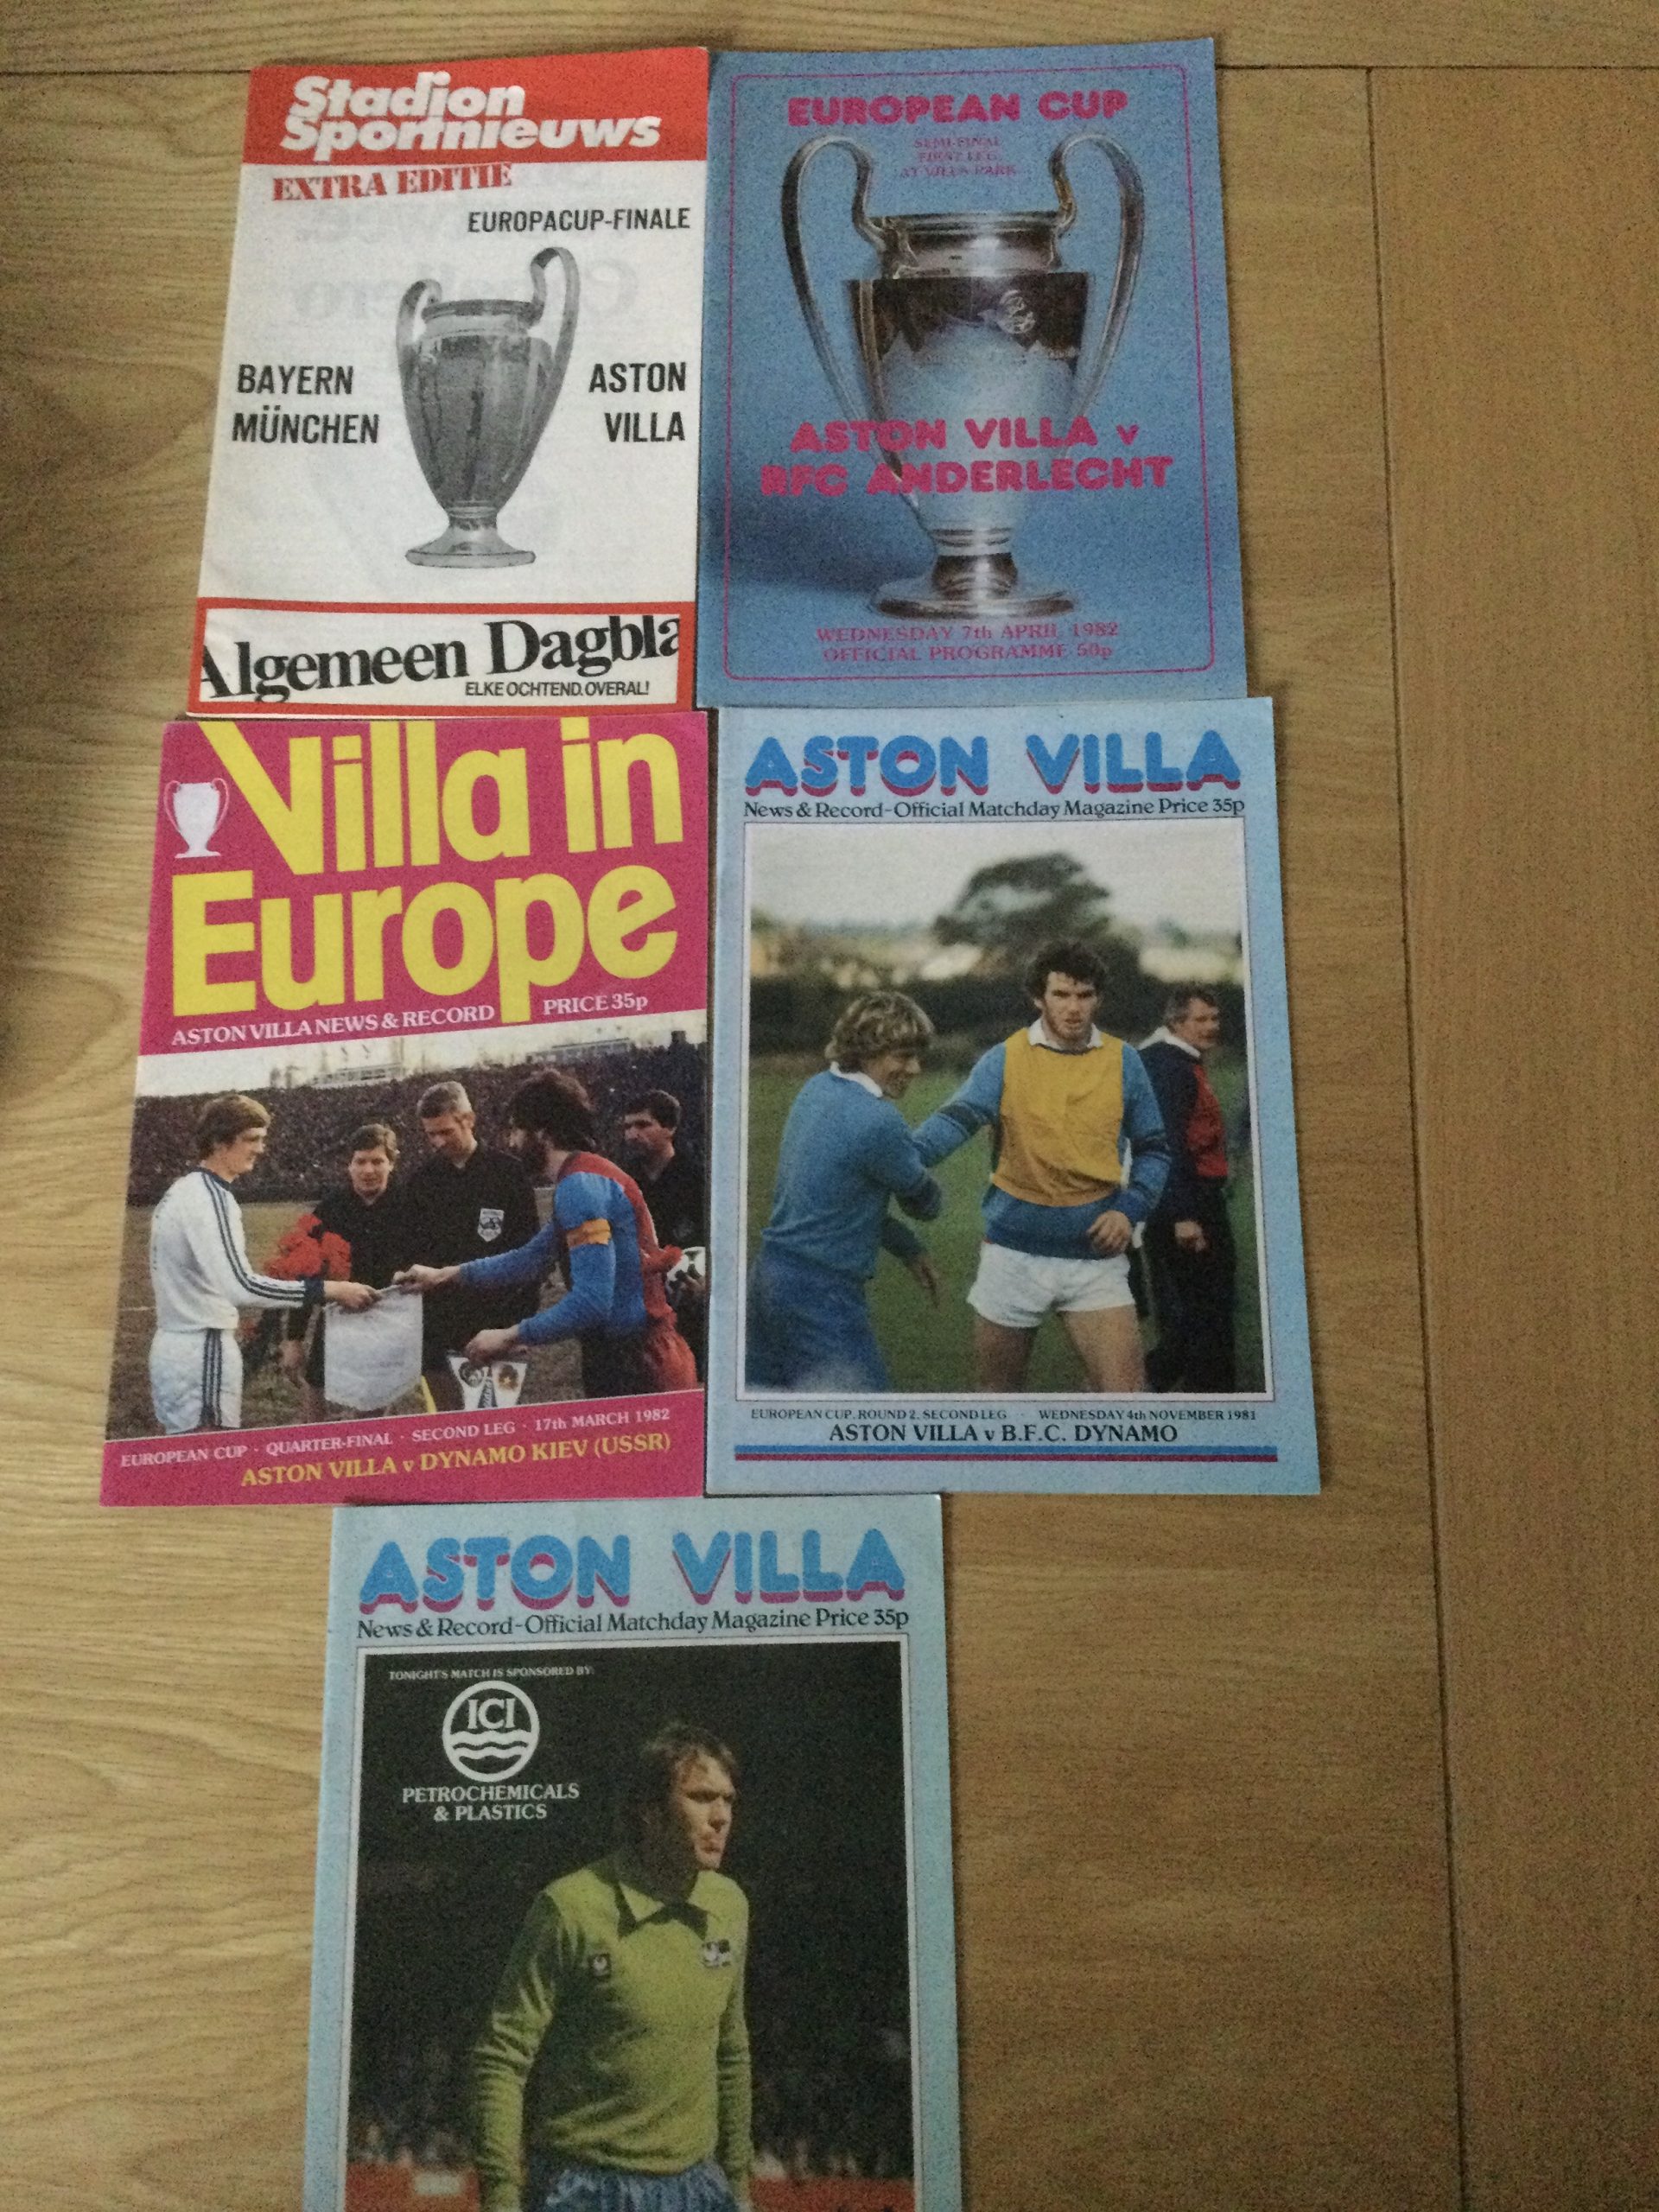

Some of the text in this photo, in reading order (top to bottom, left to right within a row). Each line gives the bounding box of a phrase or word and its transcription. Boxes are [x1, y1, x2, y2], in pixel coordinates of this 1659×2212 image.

[289, 71, 525, 119] Stadion
[787, 90, 1129, 126] EUROPEAN CUP
[280, 116, 661, 162] Sportnieuws
[272, 163, 513, 201] EXTRA EDITIE
[467, 208, 691, 233] EUROPACUP-FINALE
[237, 364, 353, 395] BAYERN
[588, 362, 687, 393] ASTON
[232, 405, 379, 444] MÜNCHEN
[605, 412, 686, 442] VILLA
[789, 416, 1140, 454] ASTON VILLA v
[760, 455, 1173, 497] RFC ANDERLECHT
[816, 621, 1119, 643] WEDNESDAY 7th APRIL 1982
[823, 642, 1113, 663] OFFICIAL PROGRAMME 50p
[465, 681, 503, 696] ELKE
[585, 681, 649, 696] OVERAL!
[745, 730, 1241, 798] ASTON VILLA
[198, 716, 684, 875] Villa in
[743, 801, 793, 817] News
[795, 802, 811, 817] &
[968, 800, 1060, 818] Matchday
[1062, 799, 1154, 817] Magazine
[1158, 798, 1211, 814] Price
[1213, 798, 1245, 815] 35p
[172, 865, 678, 1024] Europe
[543, 991, 649, 1017] PRICE 35p
[171, 1004, 495, 1046] ASTON VILLA NEWS & RECORD
[750, 1408, 822, 1420] EUROPEAN
[858, 1409, 906, 1420] ROUND
[923, 1408, 979, 1420] SECOND
[981, 1408, 1007, 1420] LEG
[1039, 1409, 1122, 1421] WEDNESDAY
[1125, 1409, 1147, 1420] 4th
[1149, 1409, 1224, 1421] NOVEMBER
[1227, 1409, 1256, 1420] 1981
[120, 1408, 671, 1467] EUROPEAN CUP QUARTER-FINAL SECOND LEG 17th MARCH 1982
[830, 1424, 1178, 1442] ASTON VILLA v B.F.C. DYNAMO
[240, 1432, 672, 1487] ASTON VILLA v DYNAMO KIEV (USSR)
[359, 1528, 906, 1615] ASTON VILLA
[357, 1619, 412, 1638] News
[416, 1618, 434, 1637] &
[607, 1611, 708, 1633] Matchday
[711, 1610, 811, 1631] Magazine
[816, 1608, 870, 1627] Price
[874, 1609, 910, 1630] 35p
[450, 1669, 490, 1679] MATCH
[493, 1669, 503, 1678] IS
[506, 1666, 575, 1677] SPONSORED
[467, 1698, 516, 1729] ICI
[403, 1783, 580, 1803] PETROCHEMICALS
[434, 1803, 548, 1822] & PLASTICS
